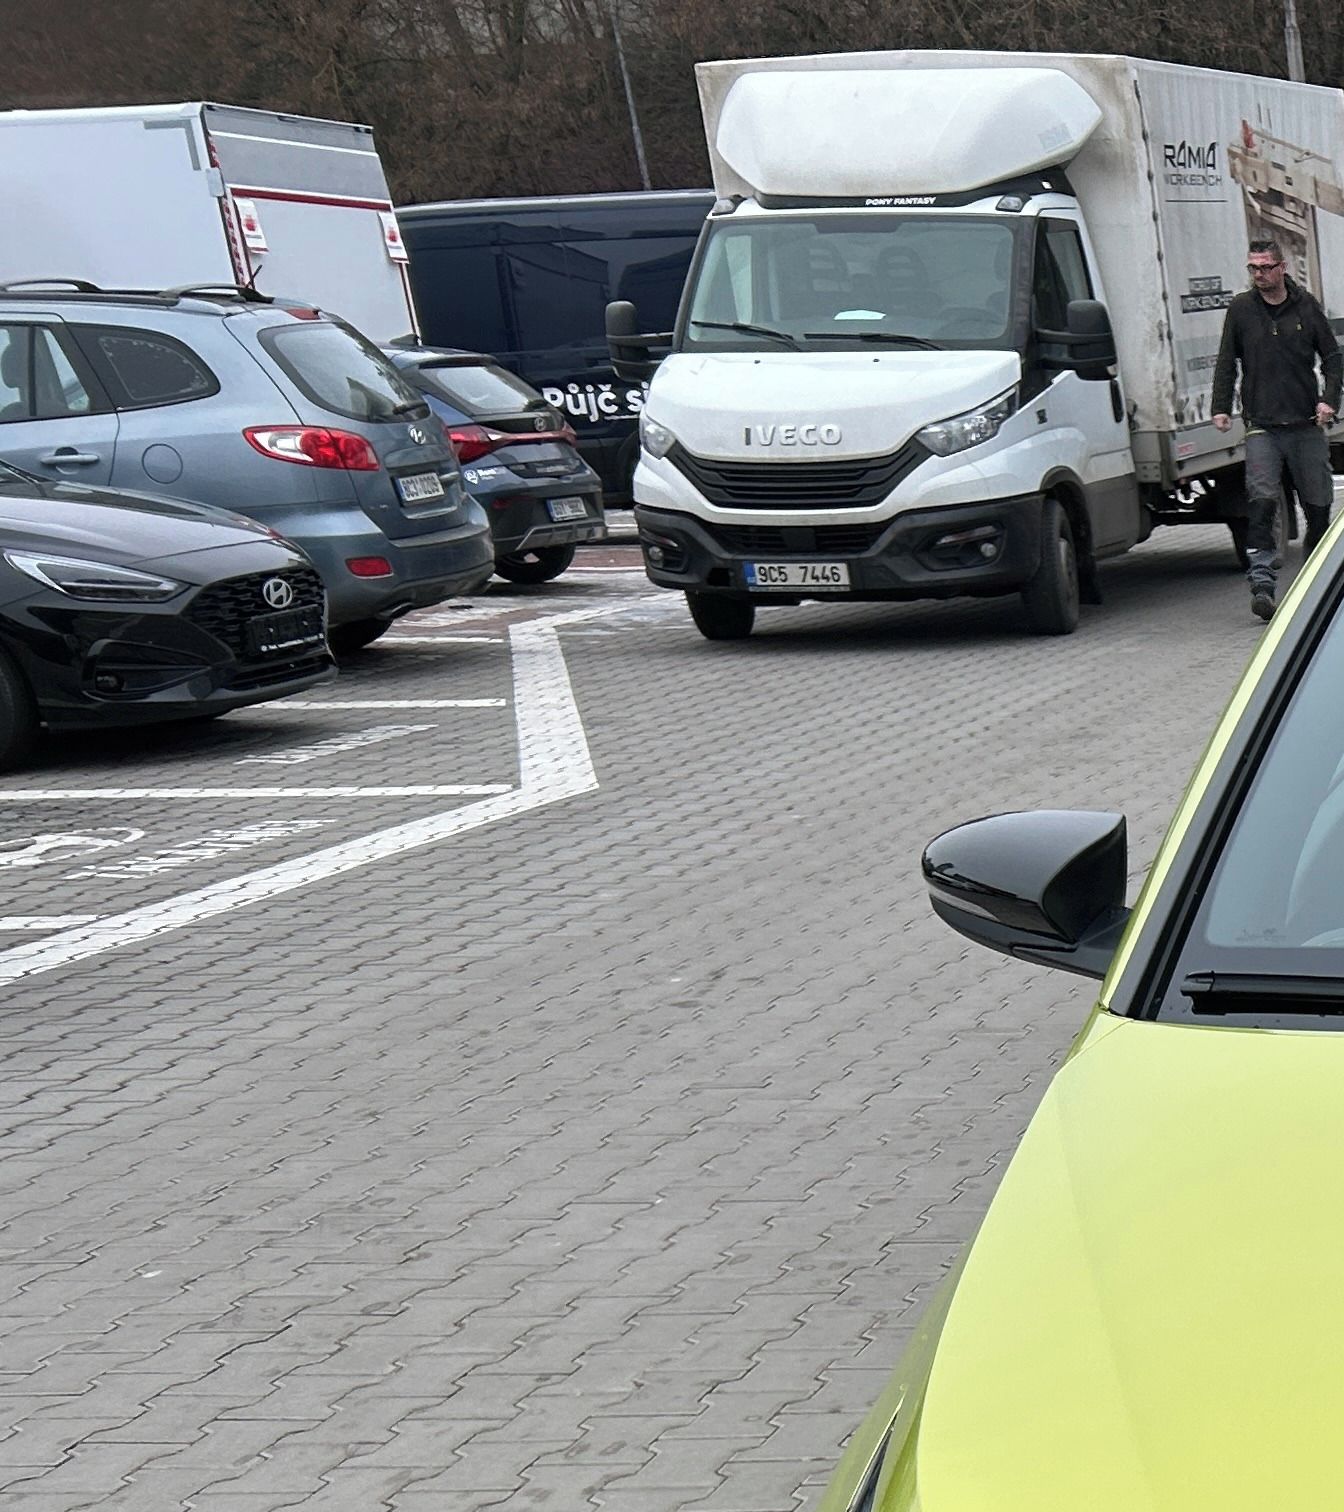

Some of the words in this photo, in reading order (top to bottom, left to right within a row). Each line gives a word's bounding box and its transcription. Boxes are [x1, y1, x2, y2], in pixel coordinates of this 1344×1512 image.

[1163, 140, 1217, 170] RAMIA
[744, 424, 842, 447] IVECO
[758, 565, 788, 583] 9C5
[798, 565, 842, 583] 7446
